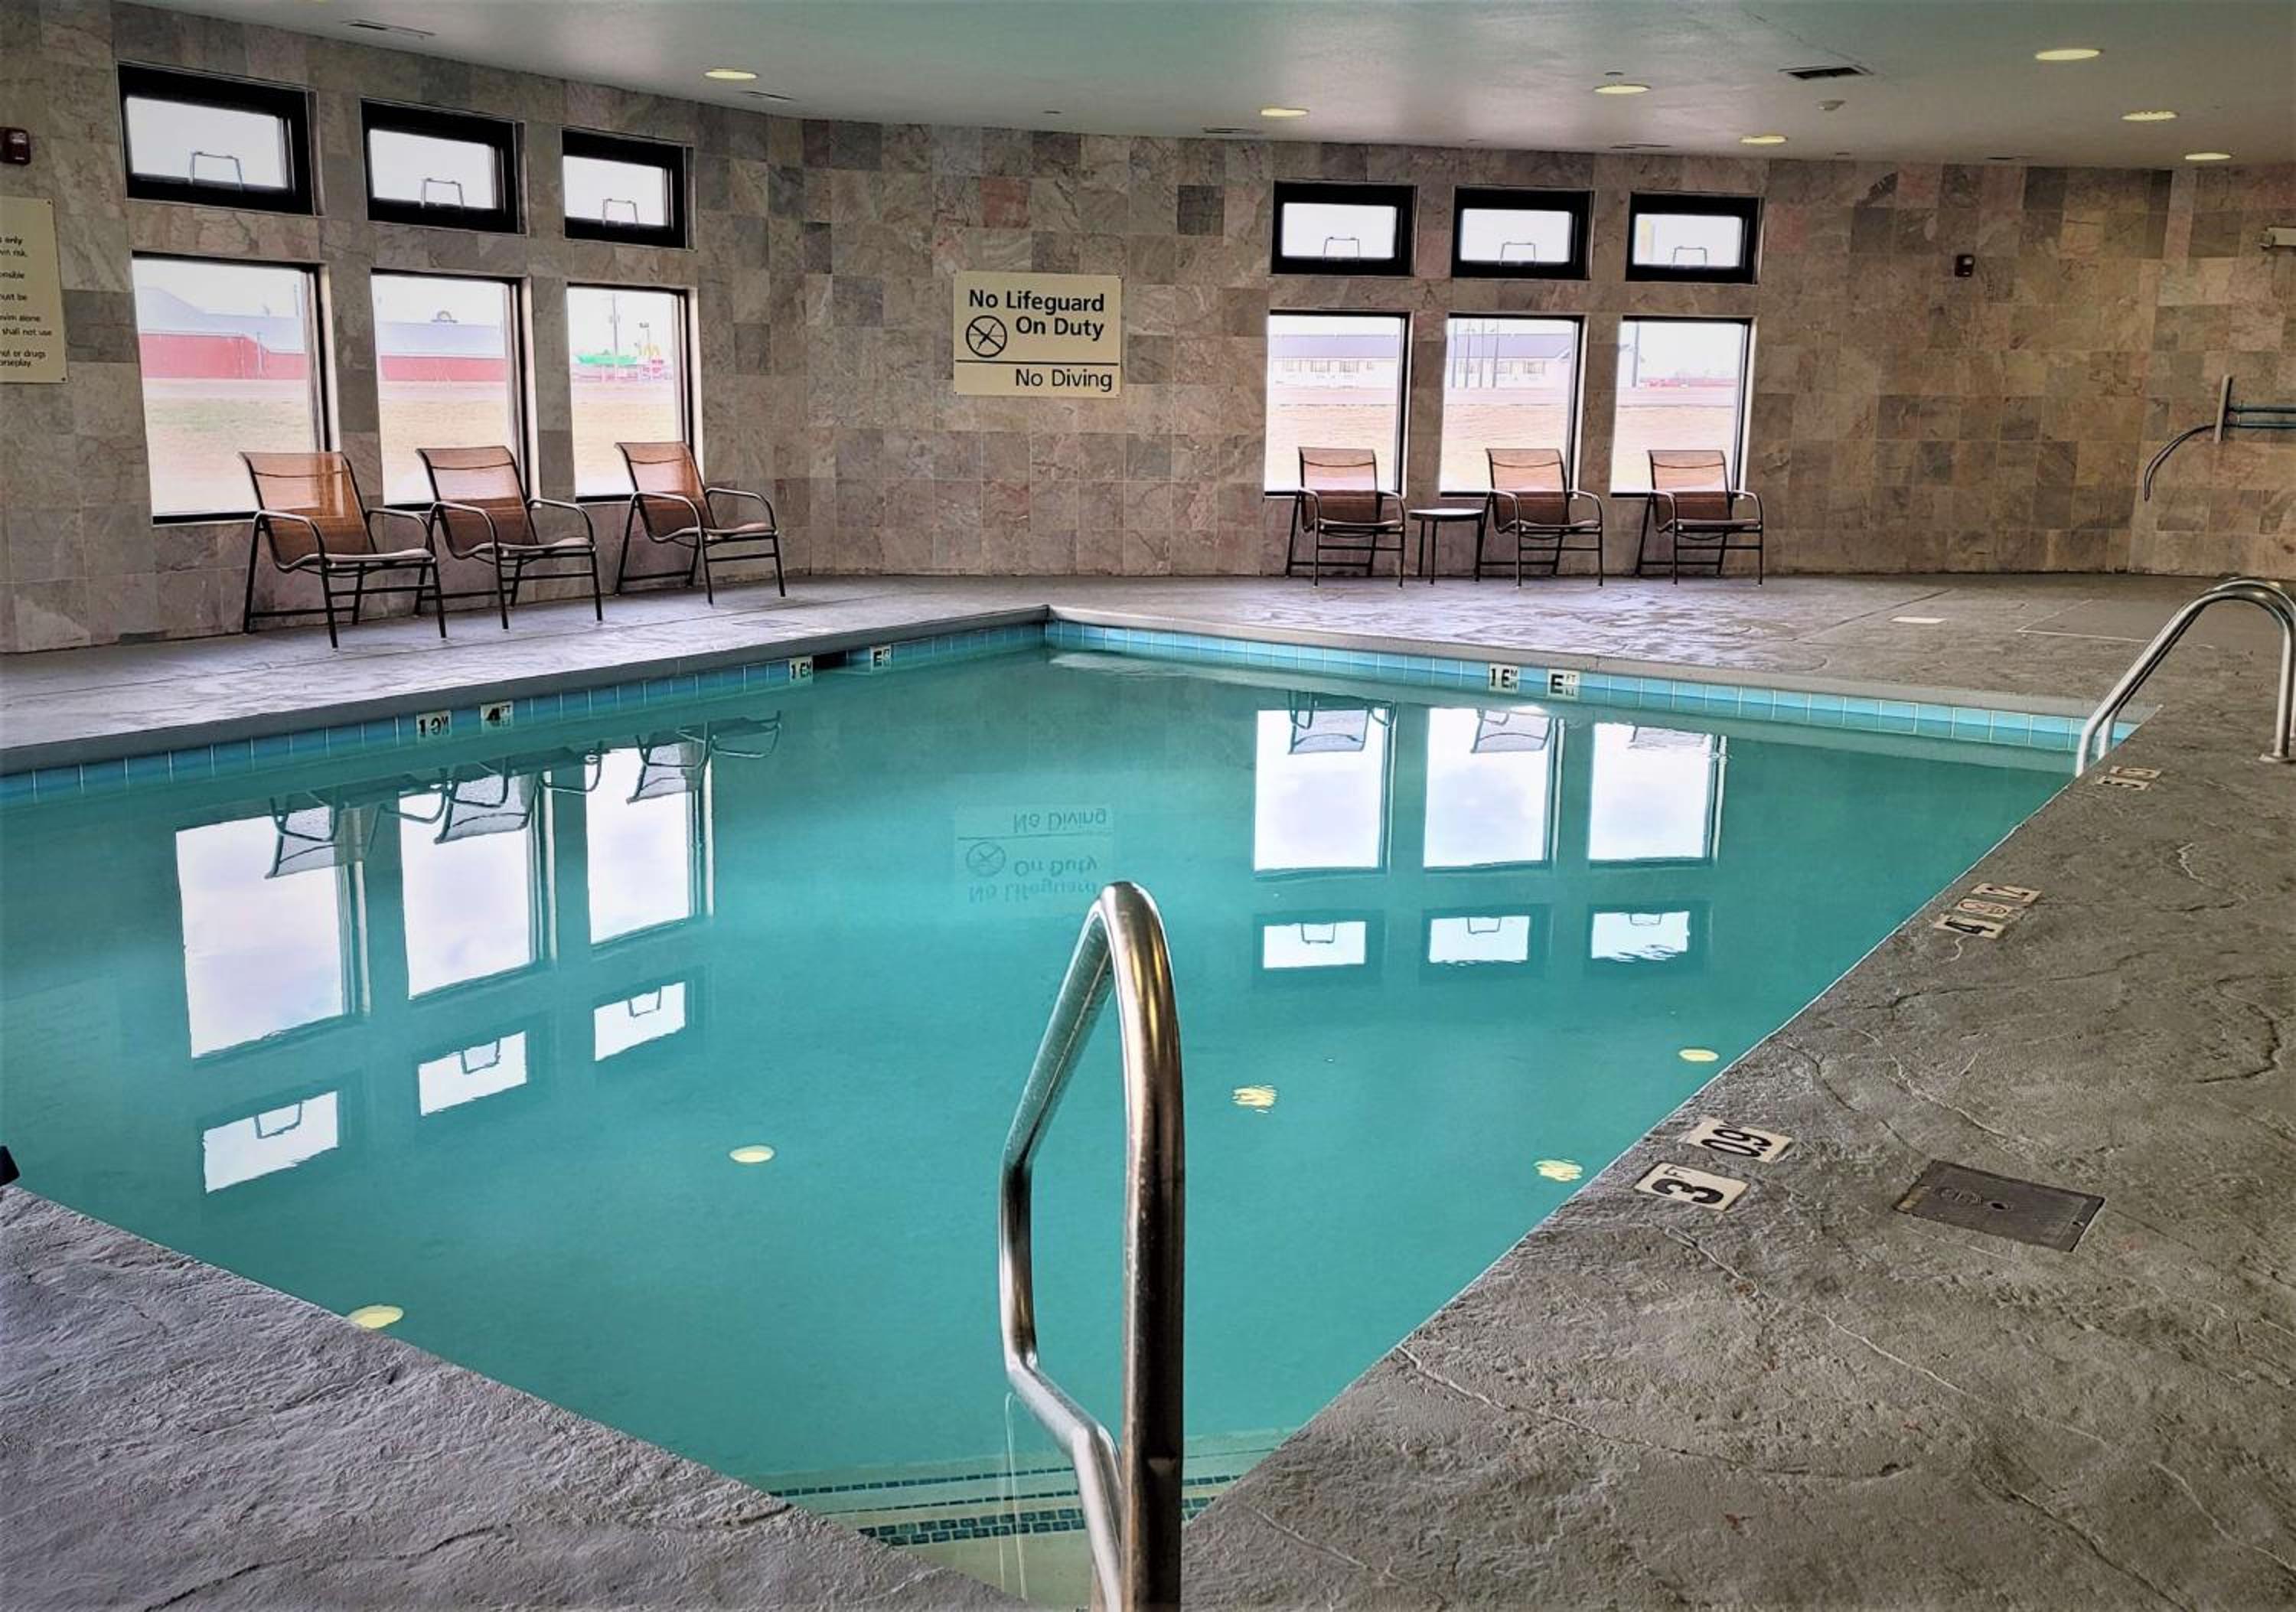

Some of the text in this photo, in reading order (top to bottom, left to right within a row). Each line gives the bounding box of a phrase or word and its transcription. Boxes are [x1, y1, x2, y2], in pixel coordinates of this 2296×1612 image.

[5, 236, 23, 246] only
[969, 289, 1104, 315] No Lifeguard
[2, 328, 20, 336] shall
[1016, 315, 1104, 341] On Duty
[24, 349, 46, 360] drugs
[1016, 368, 1113, 393] No Diving
[1944, 920, 1996, 935] 4
[1700, 1127, 1773, 1158] 0.9
[1651, 1166, 1724, 1204] 3 FT
